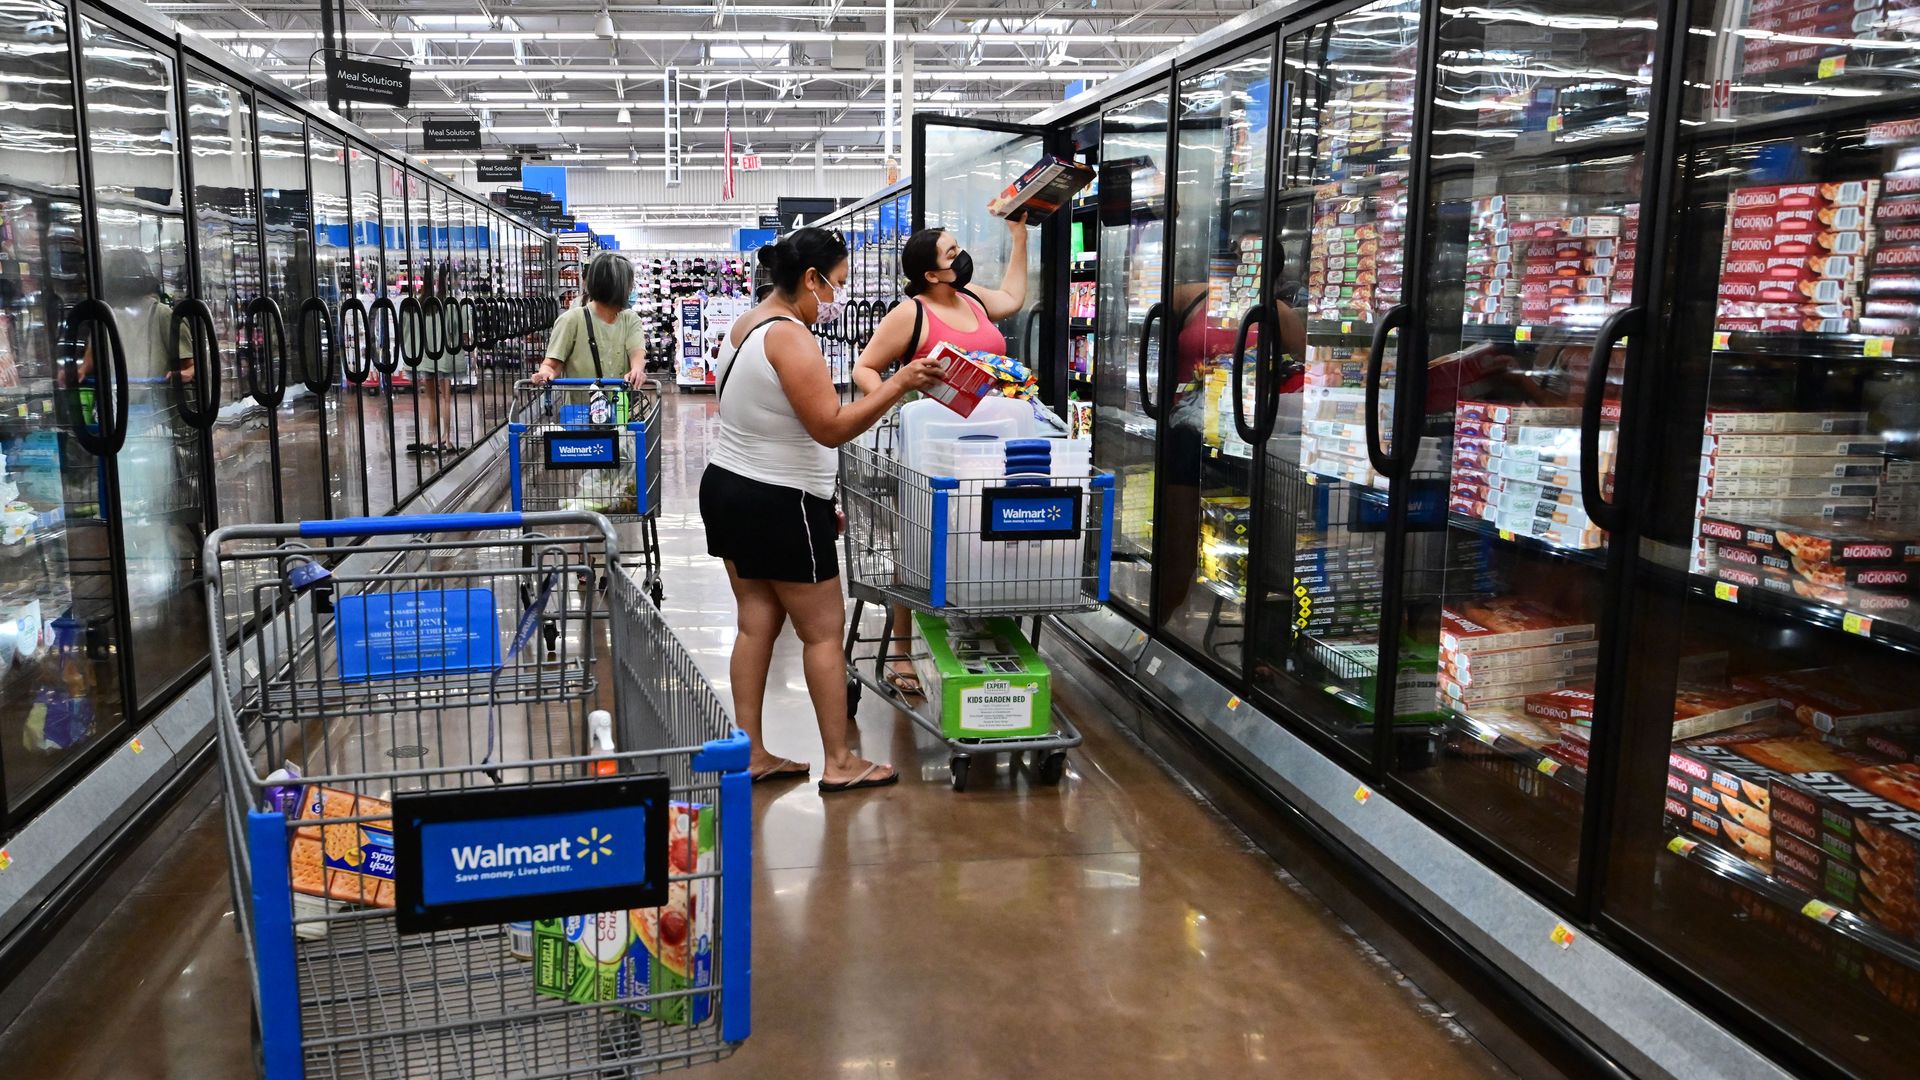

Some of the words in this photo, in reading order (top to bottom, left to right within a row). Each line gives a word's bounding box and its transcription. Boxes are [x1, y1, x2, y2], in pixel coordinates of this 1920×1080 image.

[337, 69, 360, 81] Meal
[361, 73, 403, 88] Solutions
[742, 156, 759, 170] EXIT
[1798, 186, 1817, 197] CRUST
[1737, 193, 1777, 206] DIGIORNO
[792, 213, 804, 229] 4
[1795, 210, 1814, 221] CRUST
[1734, 216, 1773, 229] DIGIORNO
[1731, 239, 1772, 251] DIGIORNO
[1794, 233, 1813, 244] CRUST
[1726, 262, 1765, 273] DIGIORNO
[1786, 257, 1805, 268] CRUST
[1718, 283, 1756, 295] DIGIORNO
[1777, 280, 1795, 292] CRUST
[559, 445, 592, 454] Walmart
[1002, 508, 1046, 519] Walmart
[1702, 522, 1742, 541] DIGIORNO
[1747, 531, 1773, 544] STUFFED
[1719, 547, 1757, 565] DIGIORNO
[1843, 546, 1892, 558] DIGIORNO
[1762, 556, 1789, 569] STUFFED
[1857, 573, 1907, 584] DIGIORNO
[1860, 597, 1909, 609] DIGIORNO
[385, 617, 448, 629] CALIFORNIA
[986, 682, 1007, 690] EXPERT
[984, 695, 1011, 703] GARDEN
[1013, 695, 1026, 703] BED
[1527, 704, 1568, 720] DIGIORNO
[1712, 772, 1739, 791] STUFFED
[1693, 786, 1719, 805] STUFFED
[1693, 811, 1719, 830] STUFFED
[451, 837, 571, 870] Walmart
[369, 861, 394, 874] Fresh
[455, 873, 479, 883] Save
[480, 871, 516, 881] money.
[518, 868, 538, 876] Live
[540, 864, 573, 874] better.
[542, 938, 554, 987] MOZZARELLA
[567, 945, 576, 986] CHEESES
[602, 976, 614, 1001] FREE
